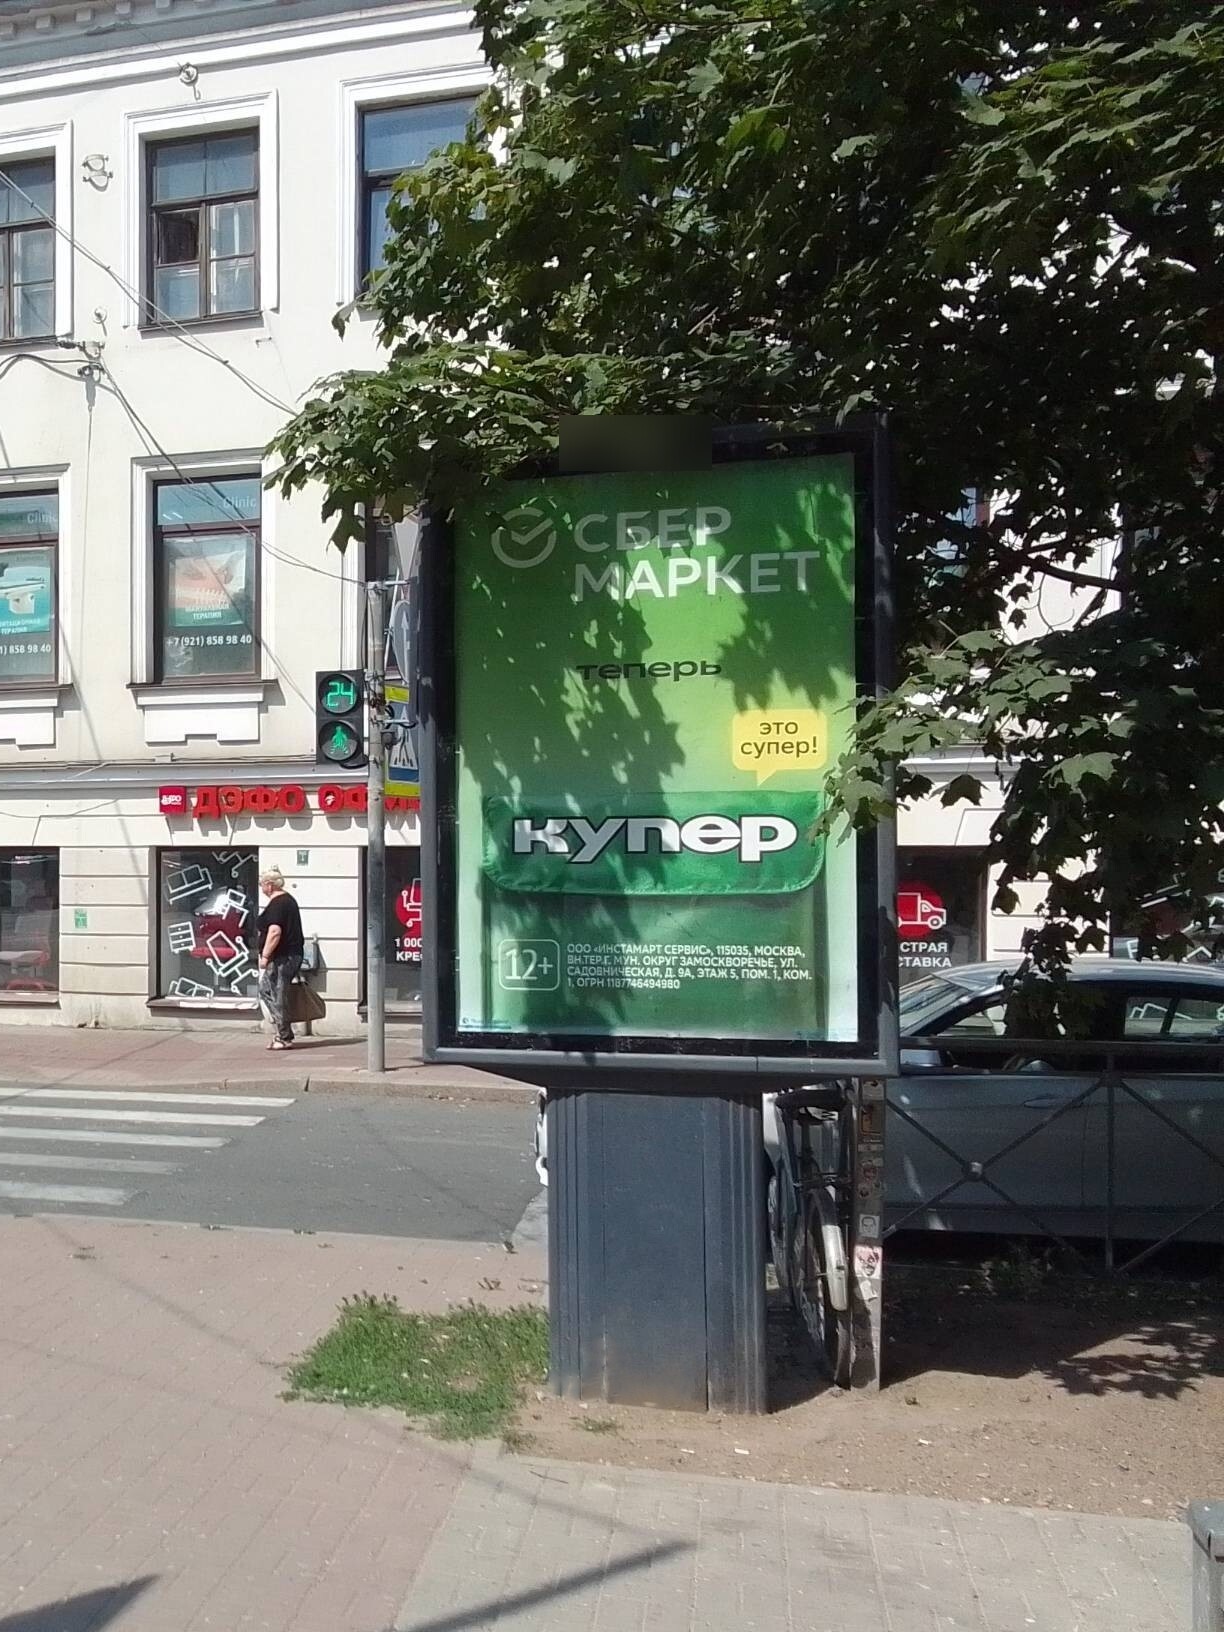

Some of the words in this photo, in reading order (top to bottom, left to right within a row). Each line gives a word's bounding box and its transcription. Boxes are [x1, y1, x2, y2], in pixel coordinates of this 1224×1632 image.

[574, 506, 732, 553] СБЕР
[575, 551, 821, 602] МАРКЕТ
[181, 635, 205, 647] (921)
[206, 635, 224, 645] 858
[226, 635, 238, 645] 98
[240, 634, 252, 644] 40
[9, 645, 26, 654] 858
[27, 644, 39, 653] 98
[40, 643, 52, 653] 40
[576, 660, 722, 682] теперь
[759, 722, 799, 735] это
[740, 736, 818, 759] супер!
[193, 784, 305, 819] ДЭФО
[513, 813, 798, 865] купер
[394, 937, 400, 947] 1
[899, 941, 948, 953] СТРАЯ
[567, 943, 591, 953] ООО
[593, 944, 663, 954] «ИНСТАМАРТ
[664, 944, 714, 956] СЕРВИС»,
[716, 945, 752, 957] 115035,
[754, 946, 806, 958] МОСКВА,
[505, 948, 553, 980] 12+
[613, 956, 641, 966] МУН.
[643, 956, 678, 966] ОКРУГ
[679, 956, 778, 968] ЗАМОСКВОРЕЧЬЕ,
[779, 957, 798, 968] УЛ.
[567, 966, 663, 978] САДОВНИЧЕСКАЯ,
[664, 968, 677, 978] Д.
[678, 968, 695, 979] 9А,
[696, 968, 728, 978] ЭТАЖ
[729, 968, 740, 980] 5,
[741, 969, 771, 979] ПОМ.
[772, 969, 781, 981] 1,
[783, 969, 813, 980] КОМ.
[567, 977, 575, 988] 1,
[577, 977, 604, 987] ОГРН
